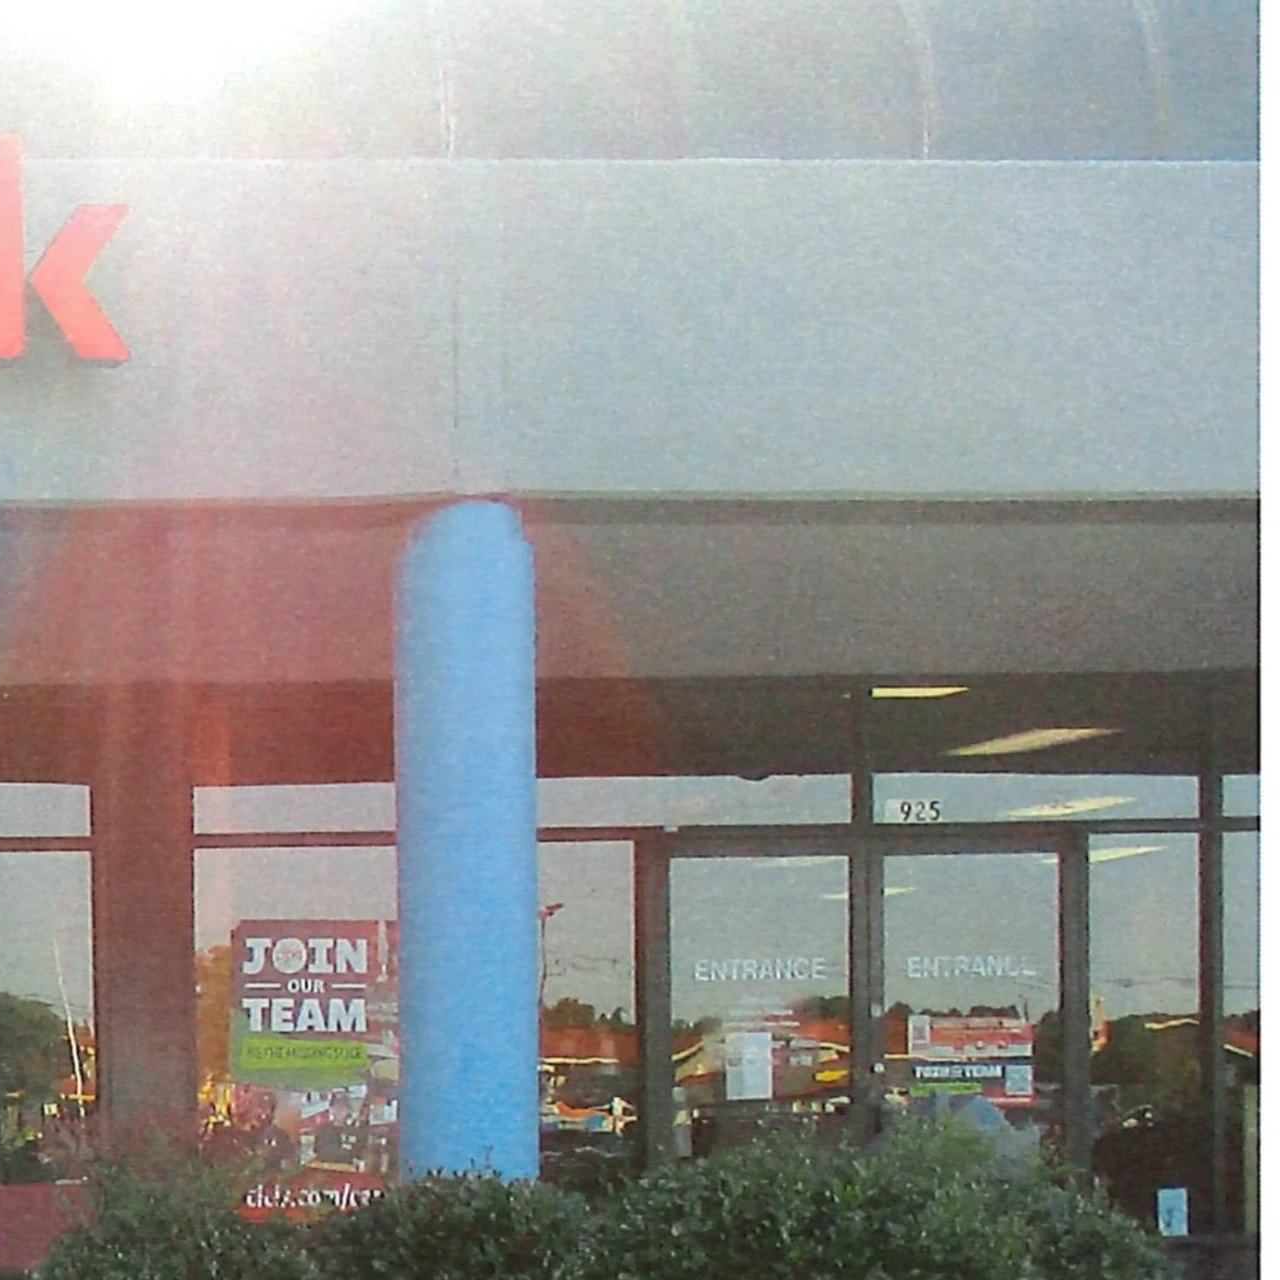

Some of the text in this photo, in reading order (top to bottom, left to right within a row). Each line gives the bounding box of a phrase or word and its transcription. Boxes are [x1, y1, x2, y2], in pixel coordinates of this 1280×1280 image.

[900, 800, 941, 822] 925
[242, 937, 368, 975] JOIN
[694, 957, 828, 983] ENTRANCE
[286, 978, 326, 994] OUR
[242, 997, 368, 1033] TEAM
